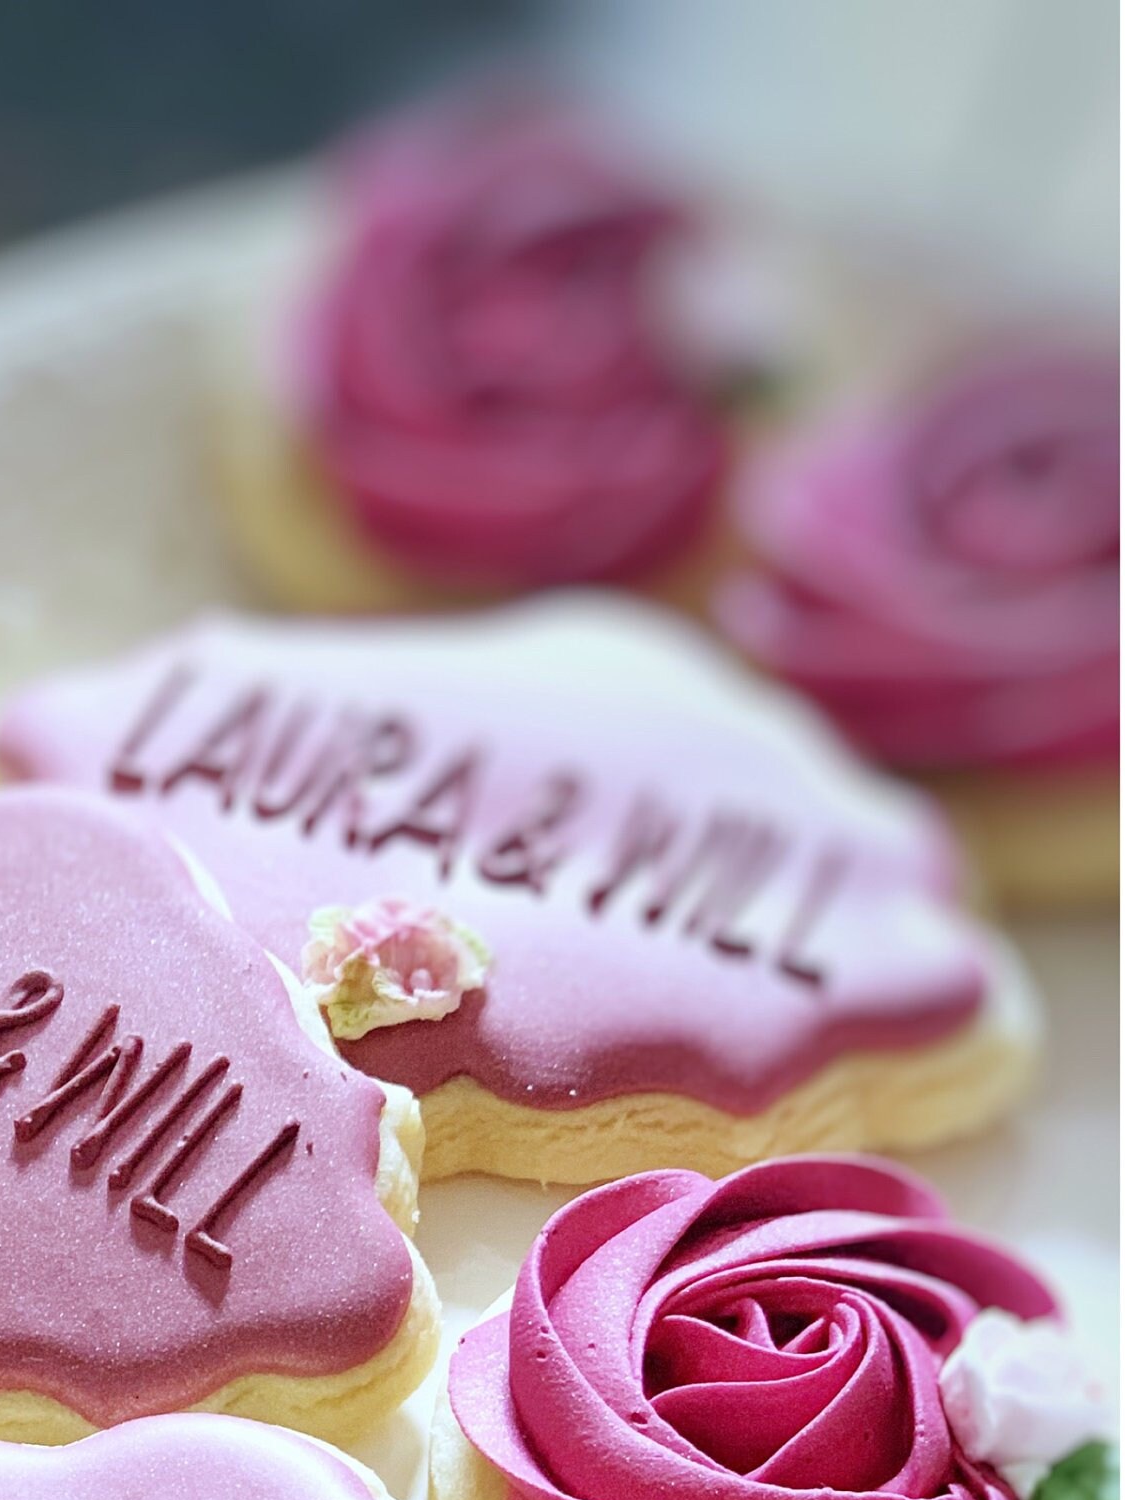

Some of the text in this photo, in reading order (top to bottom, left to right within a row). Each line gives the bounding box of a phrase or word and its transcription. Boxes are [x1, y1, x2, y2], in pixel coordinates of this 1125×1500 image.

[107, 662, 853, 990] LAURA & WILL
[14, 1003, 302, 1270] WILL
